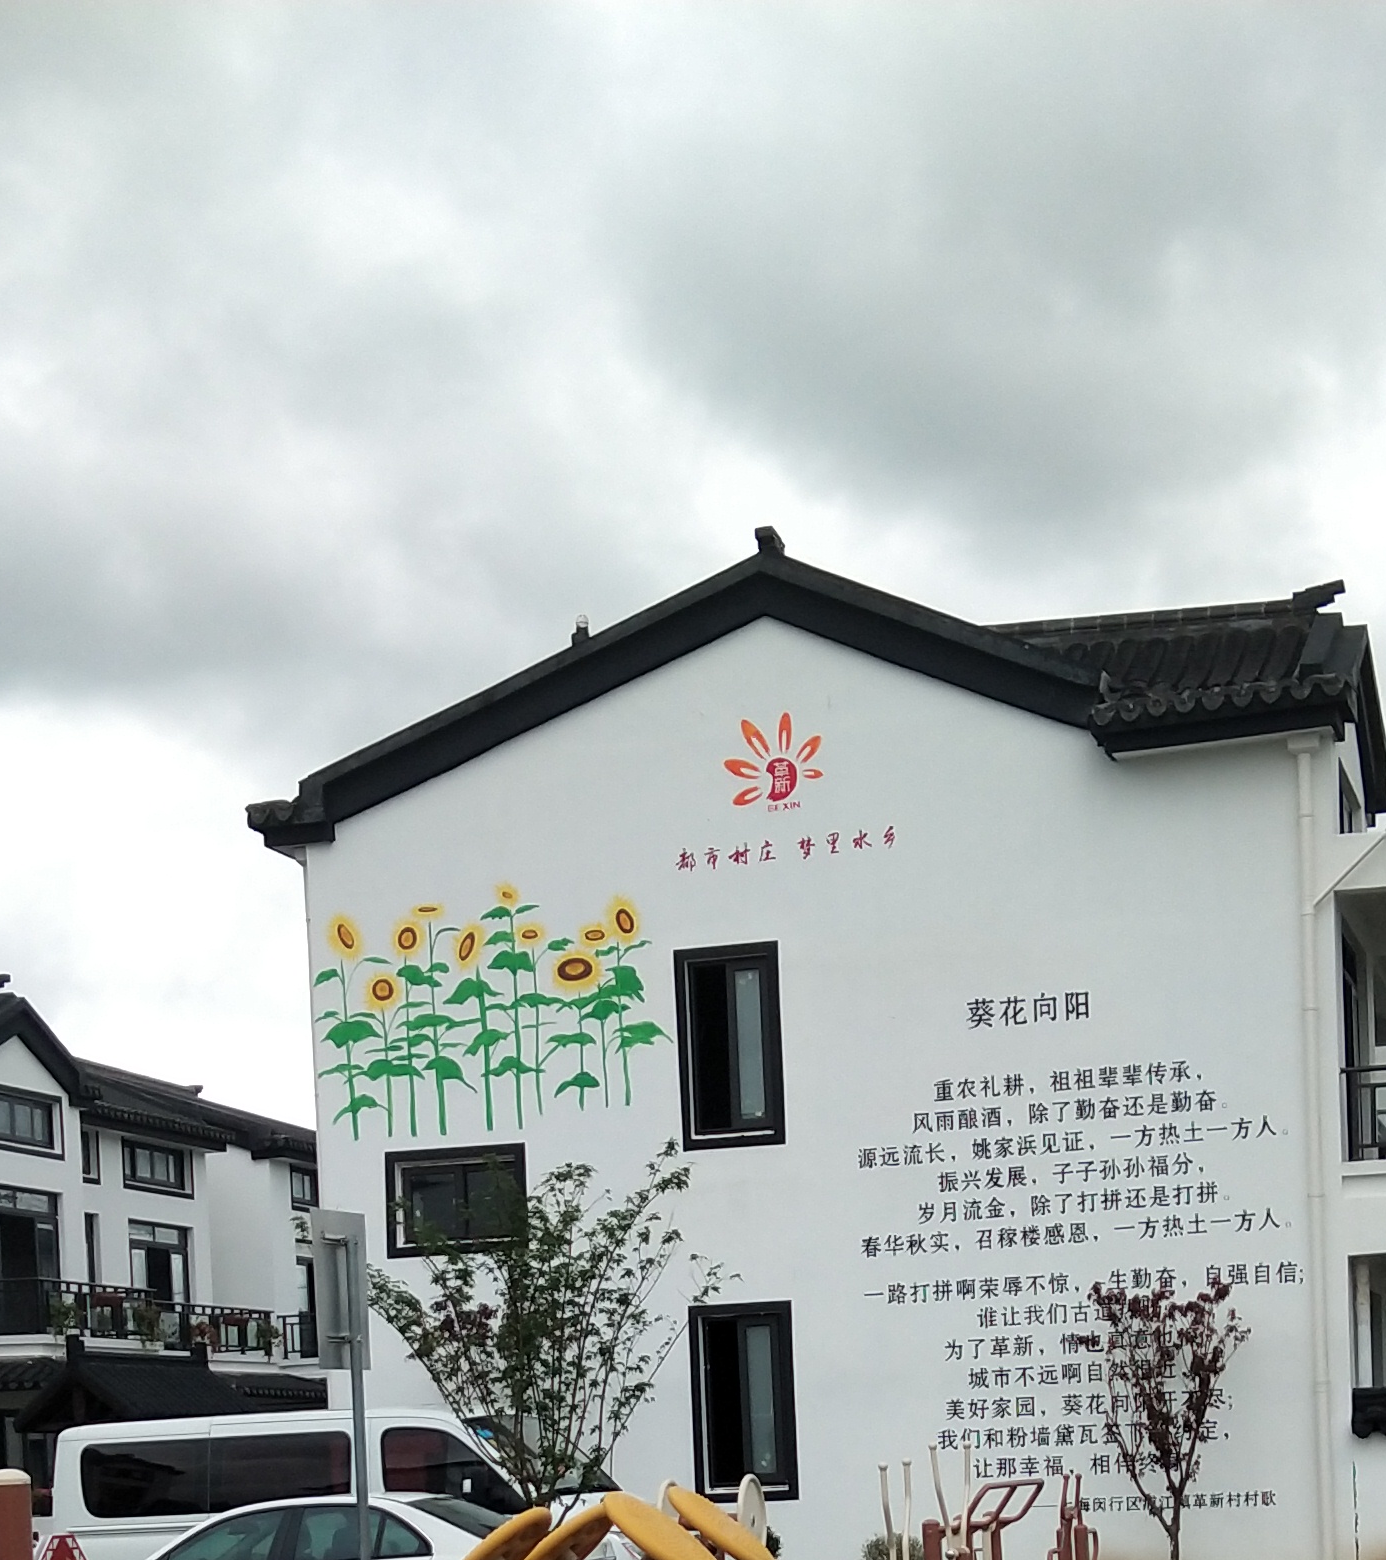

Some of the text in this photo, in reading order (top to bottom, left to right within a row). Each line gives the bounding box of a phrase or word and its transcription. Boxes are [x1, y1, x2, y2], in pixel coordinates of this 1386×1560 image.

[773, 760, 791, 794] 革新
[782, 801, 801, 811] XIN
[675, 825, 897, 872] 都市村庄 梦里水乡
[966, 991, 1090, 1029] 葵花向阳
[937, 1420, 1230, 1450] 我们和粉墙黛瓦签下约定，
